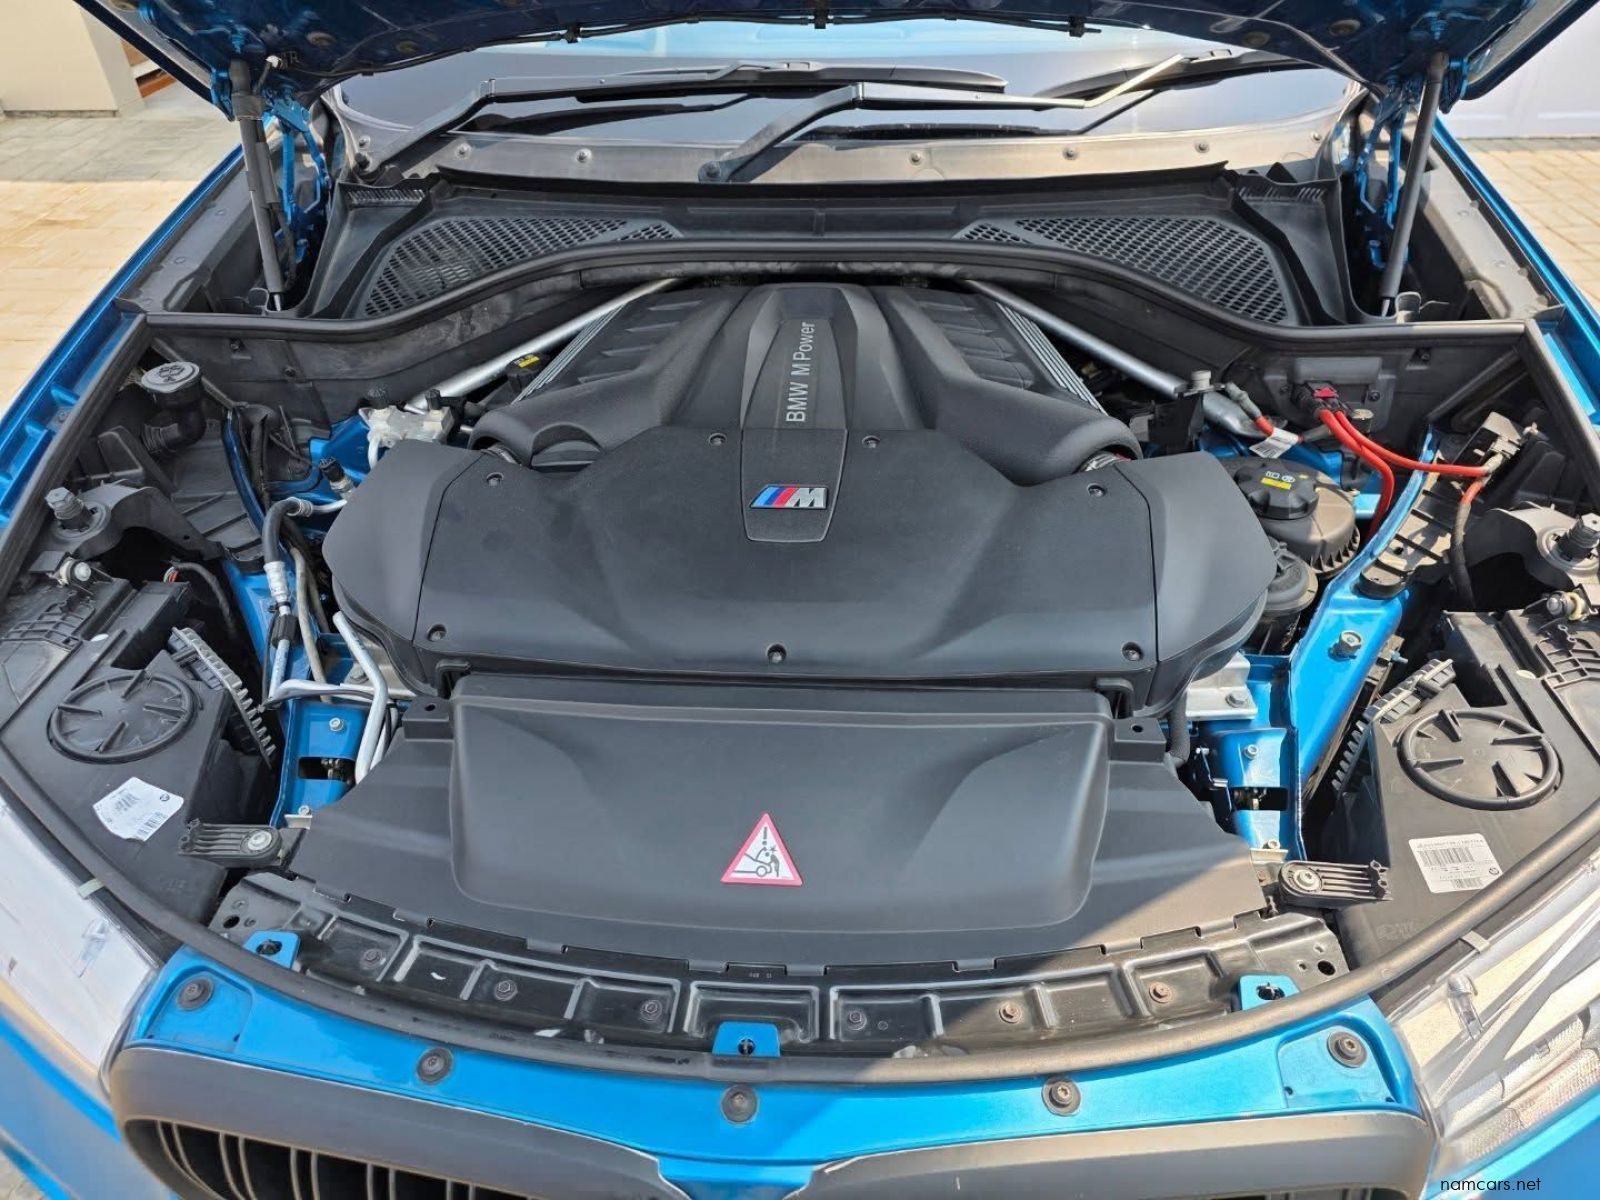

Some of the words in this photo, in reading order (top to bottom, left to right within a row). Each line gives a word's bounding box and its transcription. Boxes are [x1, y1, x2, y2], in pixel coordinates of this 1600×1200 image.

[793, 322, 816, 360] Power
[791, 363, 811, 376] M
[785, 382, 809, 422] BMW
[783, 486, 827, 509] M
